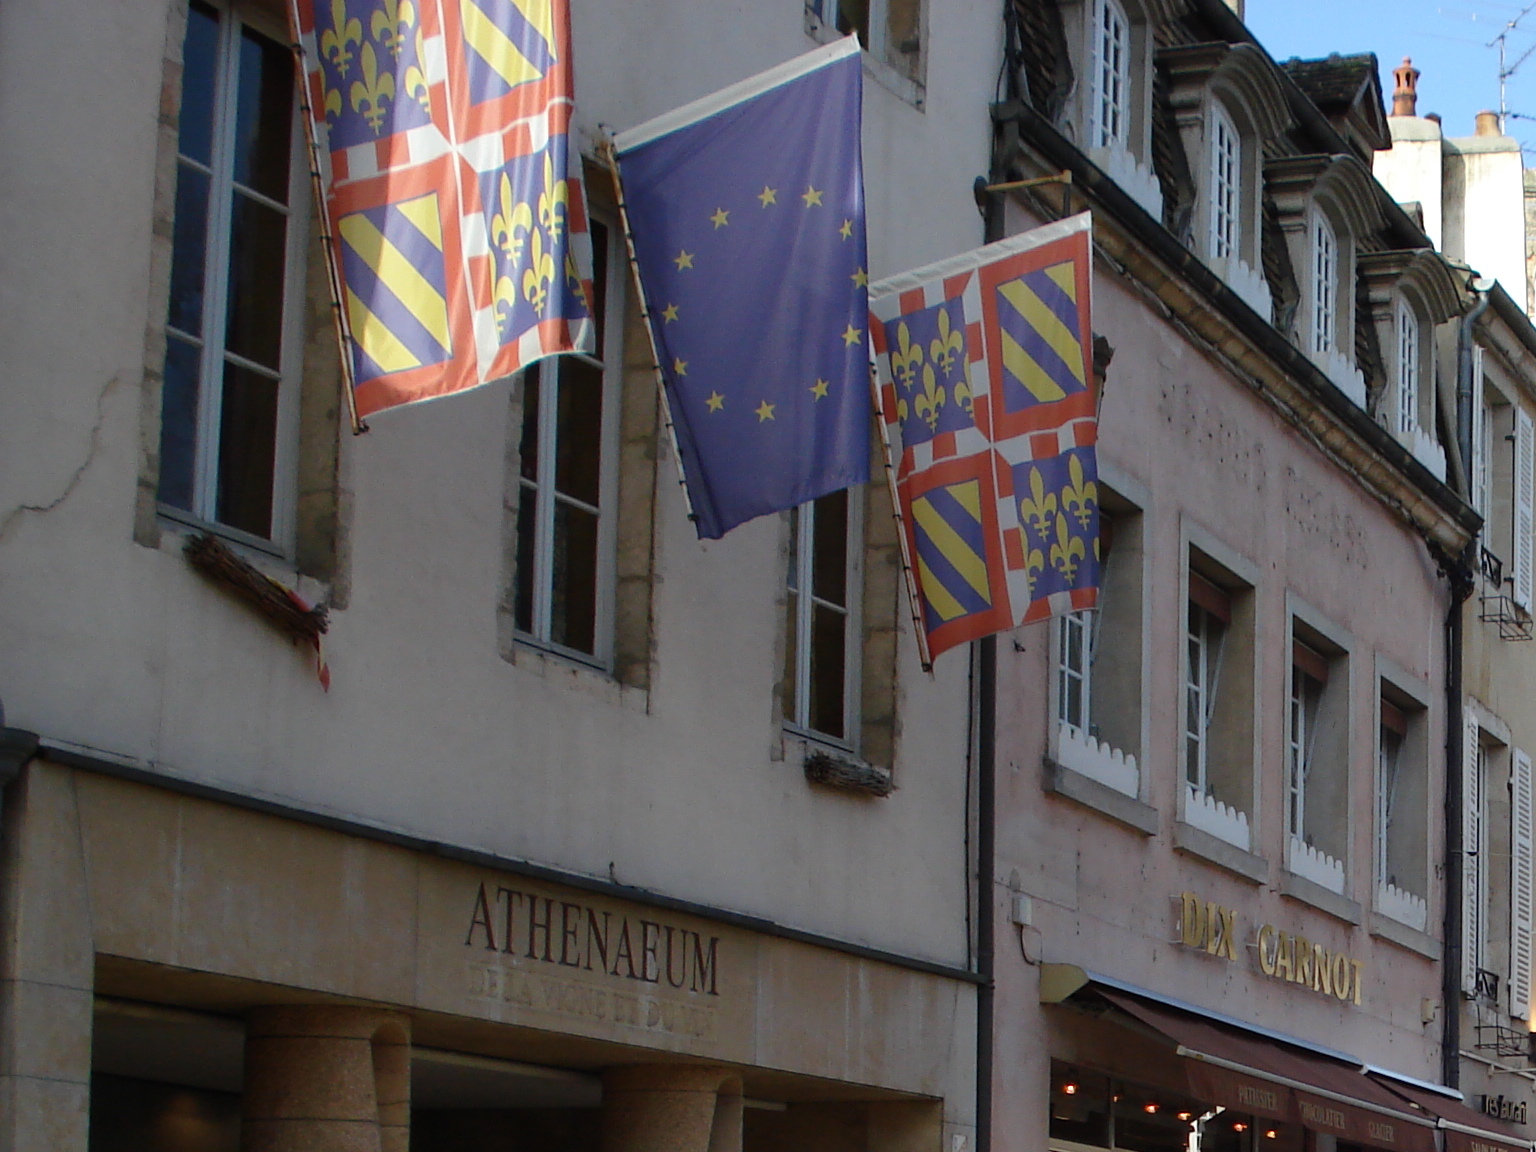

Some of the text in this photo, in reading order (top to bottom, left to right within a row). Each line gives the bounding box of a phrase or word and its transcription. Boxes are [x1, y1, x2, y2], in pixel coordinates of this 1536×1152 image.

[465, 881, 719, 996] ATHENAEUM
[1181, 890, 1365, 1006] DIX CARNOT
